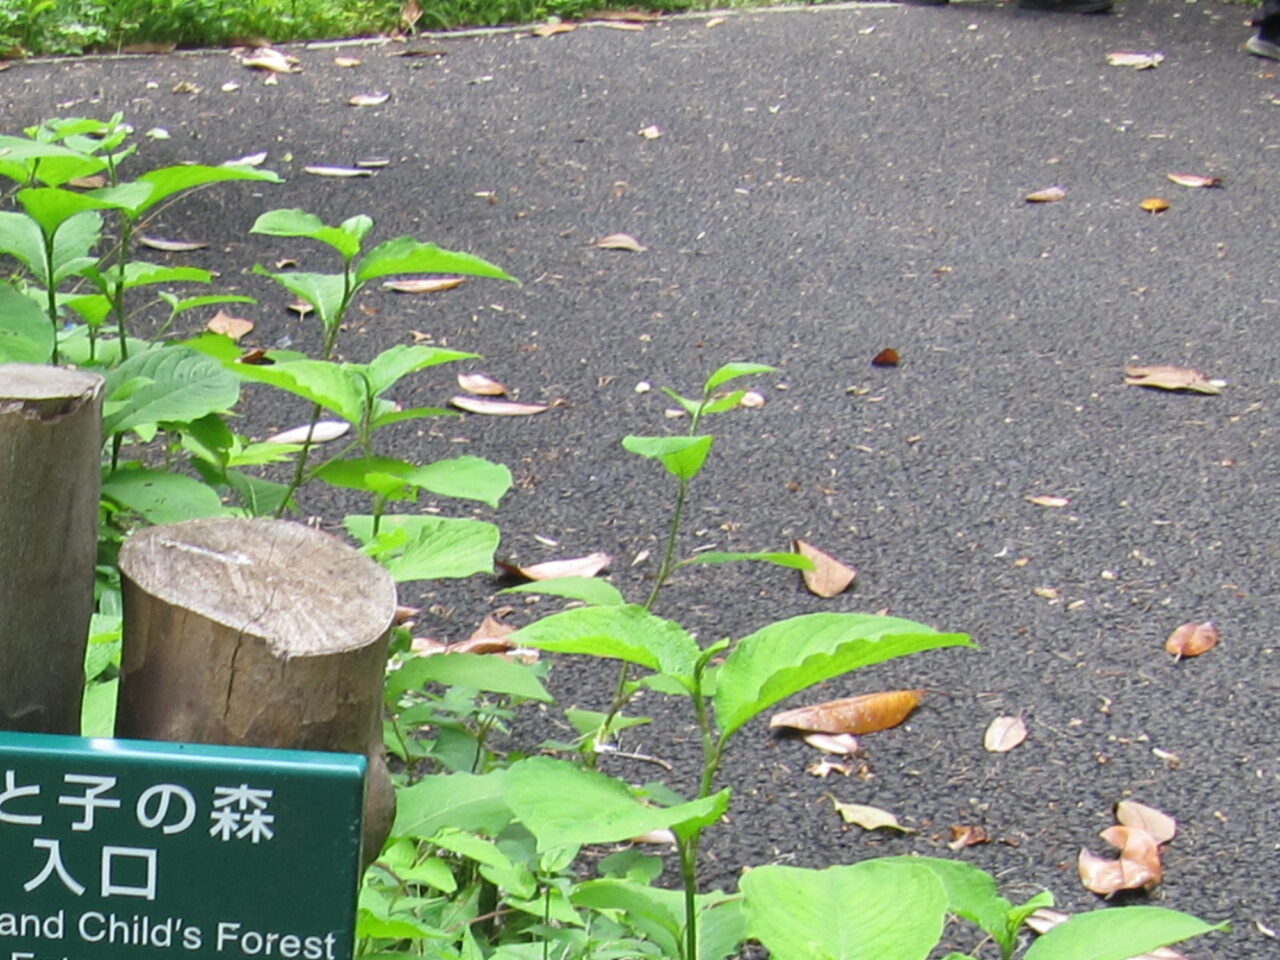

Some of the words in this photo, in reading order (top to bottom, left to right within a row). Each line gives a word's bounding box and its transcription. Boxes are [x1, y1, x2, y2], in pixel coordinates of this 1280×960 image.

[23, 837, 158, 901] 入口
[78, 910, 202, 951] Child's
[216, 921, 337, 960] Forest
